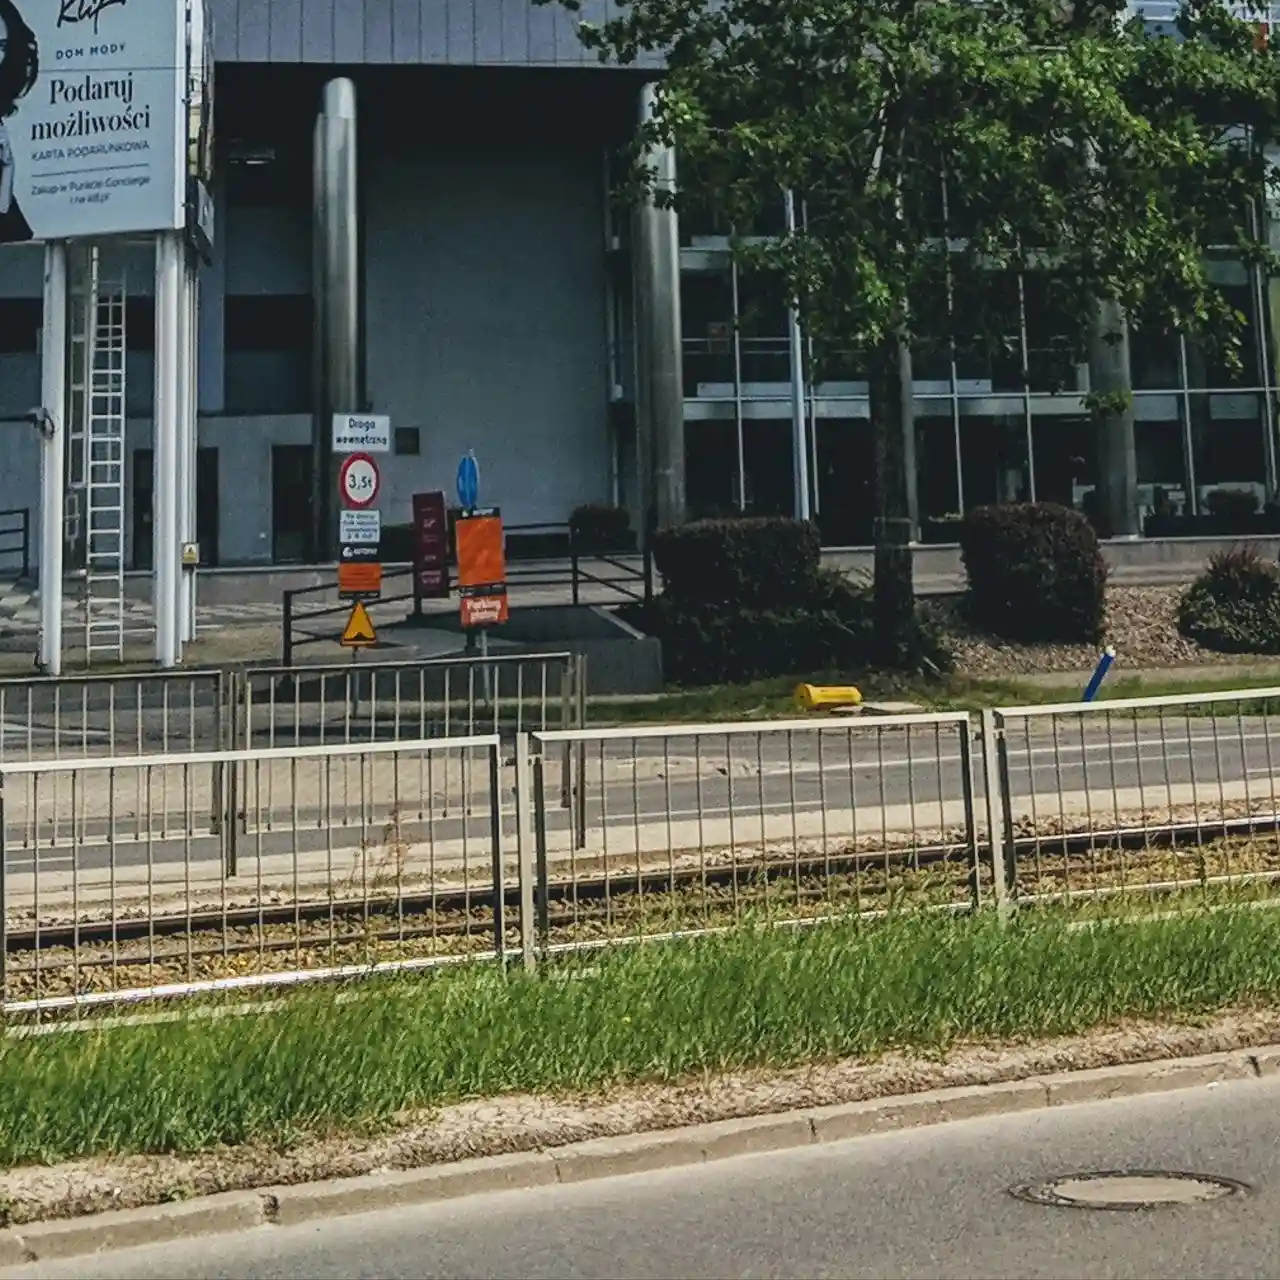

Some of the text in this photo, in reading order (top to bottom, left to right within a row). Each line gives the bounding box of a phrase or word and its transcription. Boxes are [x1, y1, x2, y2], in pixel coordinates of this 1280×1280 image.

[56, 42, 126, 60] DOM MODY
[50, 71, 133, 104] Podaruj
[31, 104, 150, 140] możliwości
[31, 148, 65, 161] KARTA
[348, 417, 376, 432] Droga
[348, 473, 373, 491] 3,5t
